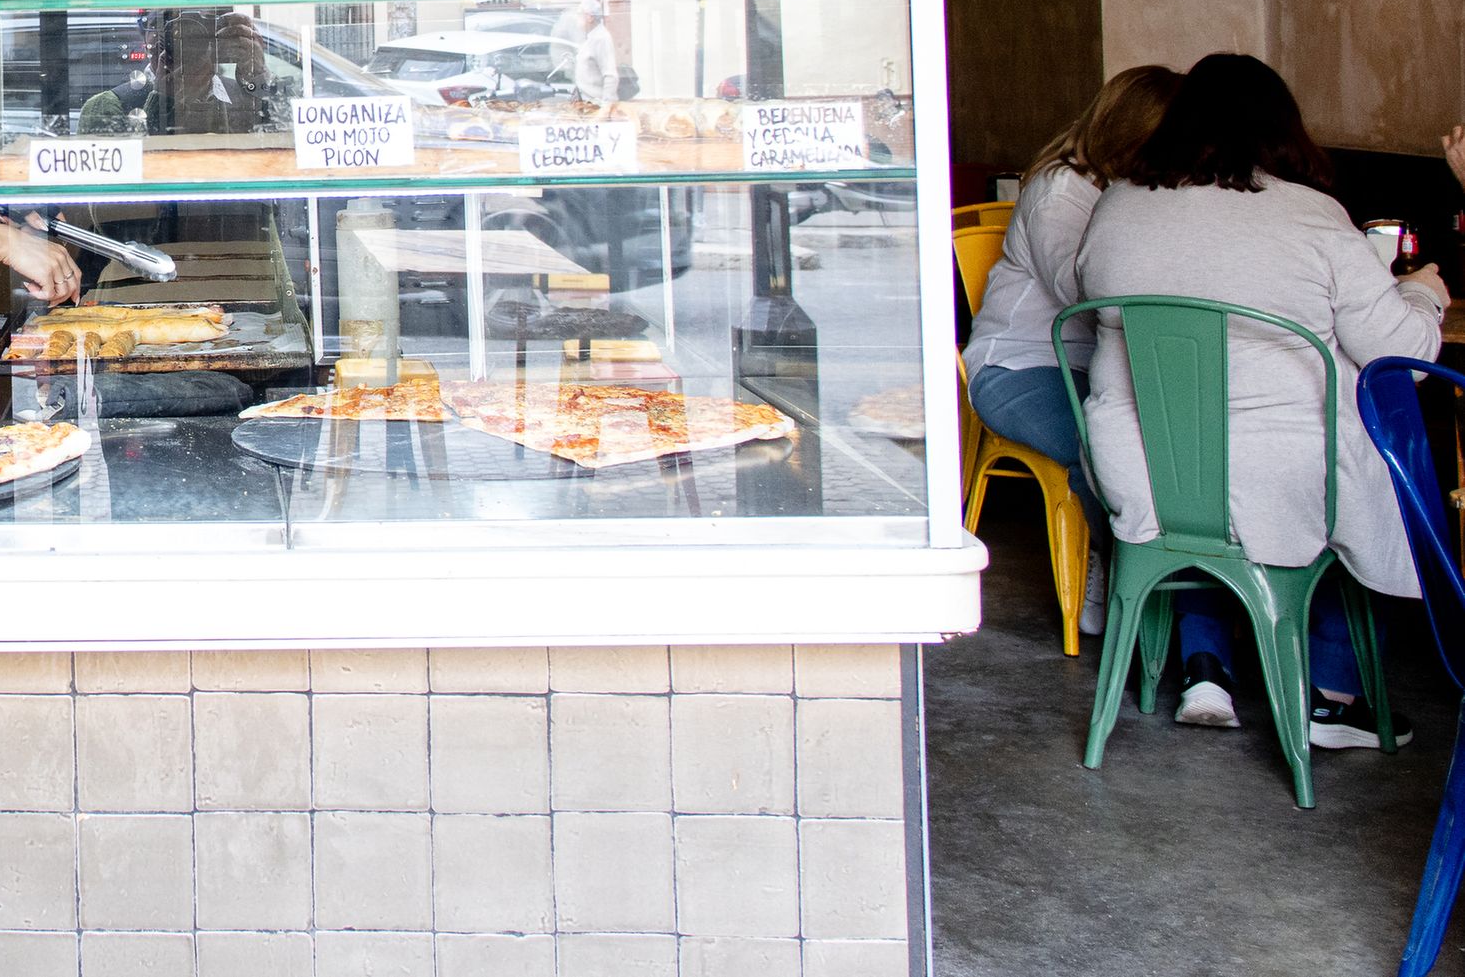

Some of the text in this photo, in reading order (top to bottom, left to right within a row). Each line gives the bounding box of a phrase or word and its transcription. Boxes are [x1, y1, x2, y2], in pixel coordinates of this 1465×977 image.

[298, 103, 406, 124] LONGANIZA
[307, 127, 390, 146] CON MOJO
[546, 125, 599, 143] BACON
[533, 145, 604, 168] CEBOLLA
